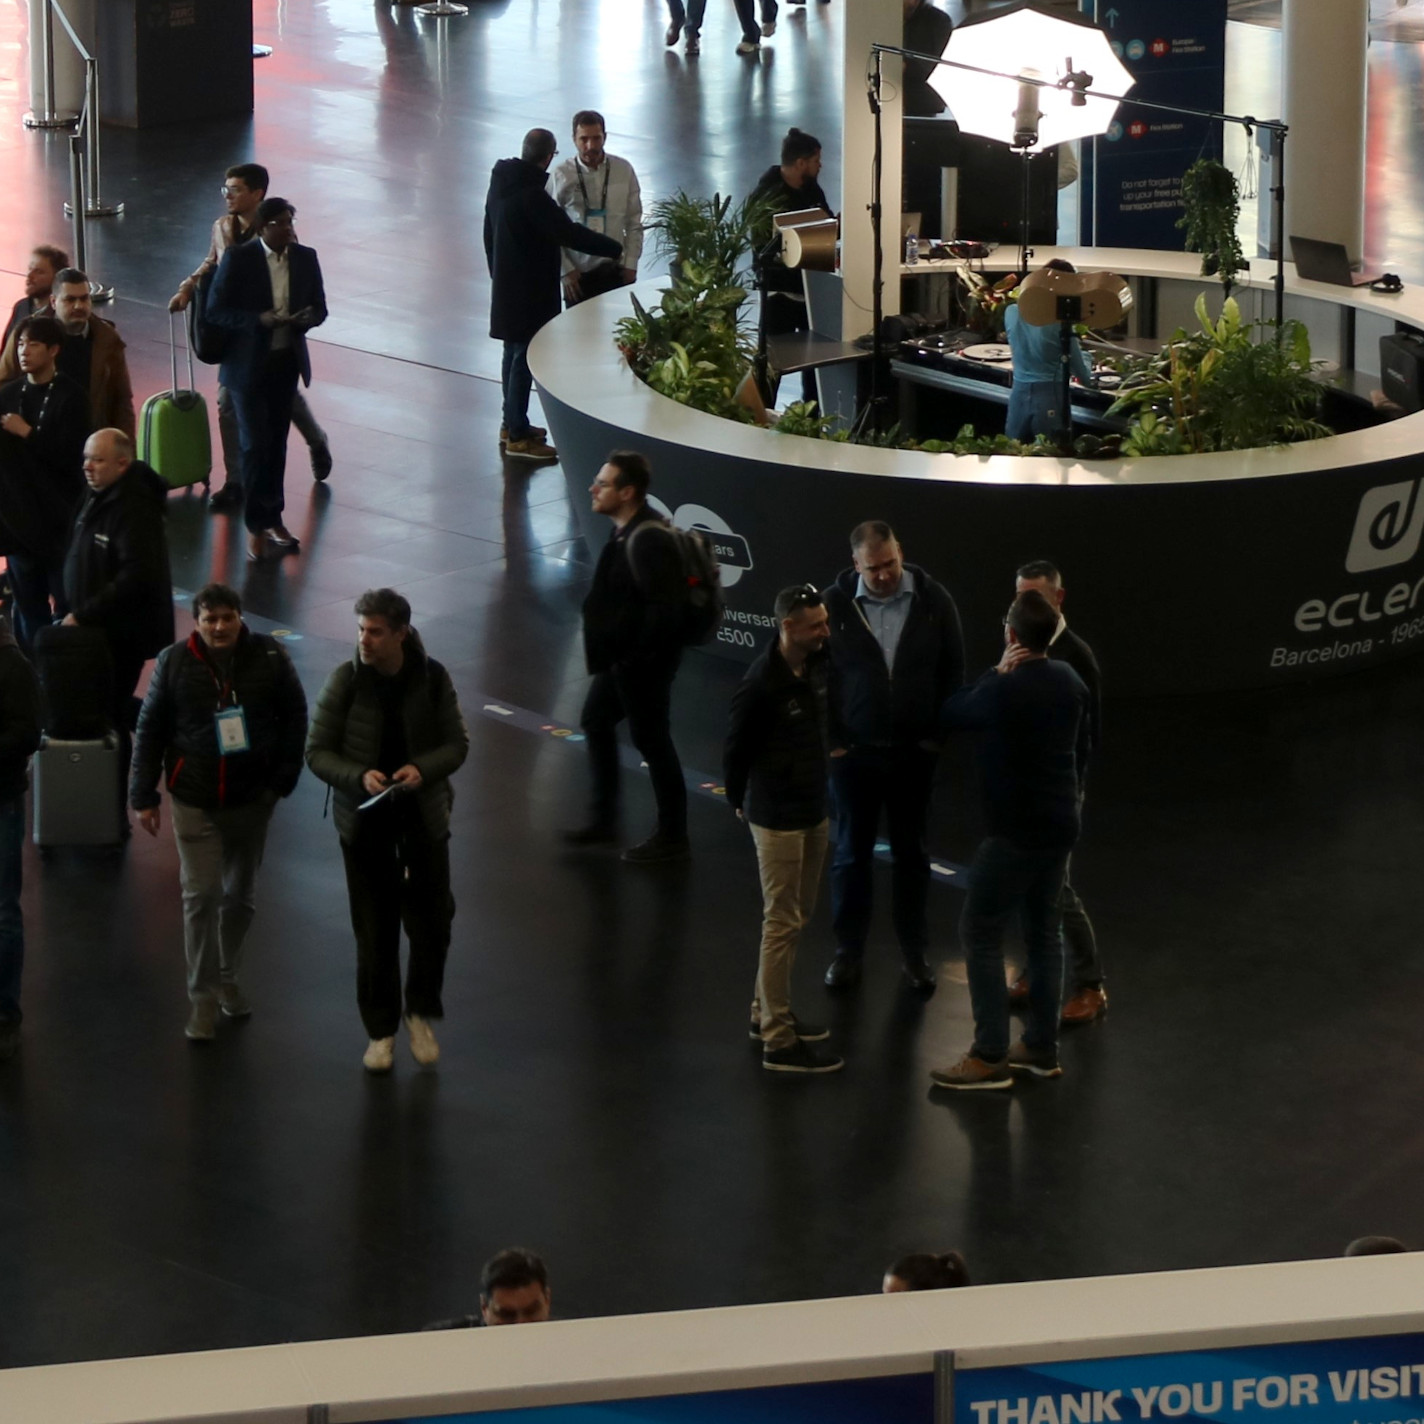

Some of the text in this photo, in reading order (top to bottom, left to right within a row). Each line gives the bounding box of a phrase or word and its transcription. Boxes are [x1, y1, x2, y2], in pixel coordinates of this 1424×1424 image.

[713, 544, 735, 557] ars
[723, 604, 778, 628] iversar
[716, 626, 755, 648] E500
[1269, 637, 1373, 669] Barcelona
[971, 1389, 1122, 1424] THANK
[1132, 1380, 1224, 1420] YOU
[1232, 1372, 1319, 1411] FOR
